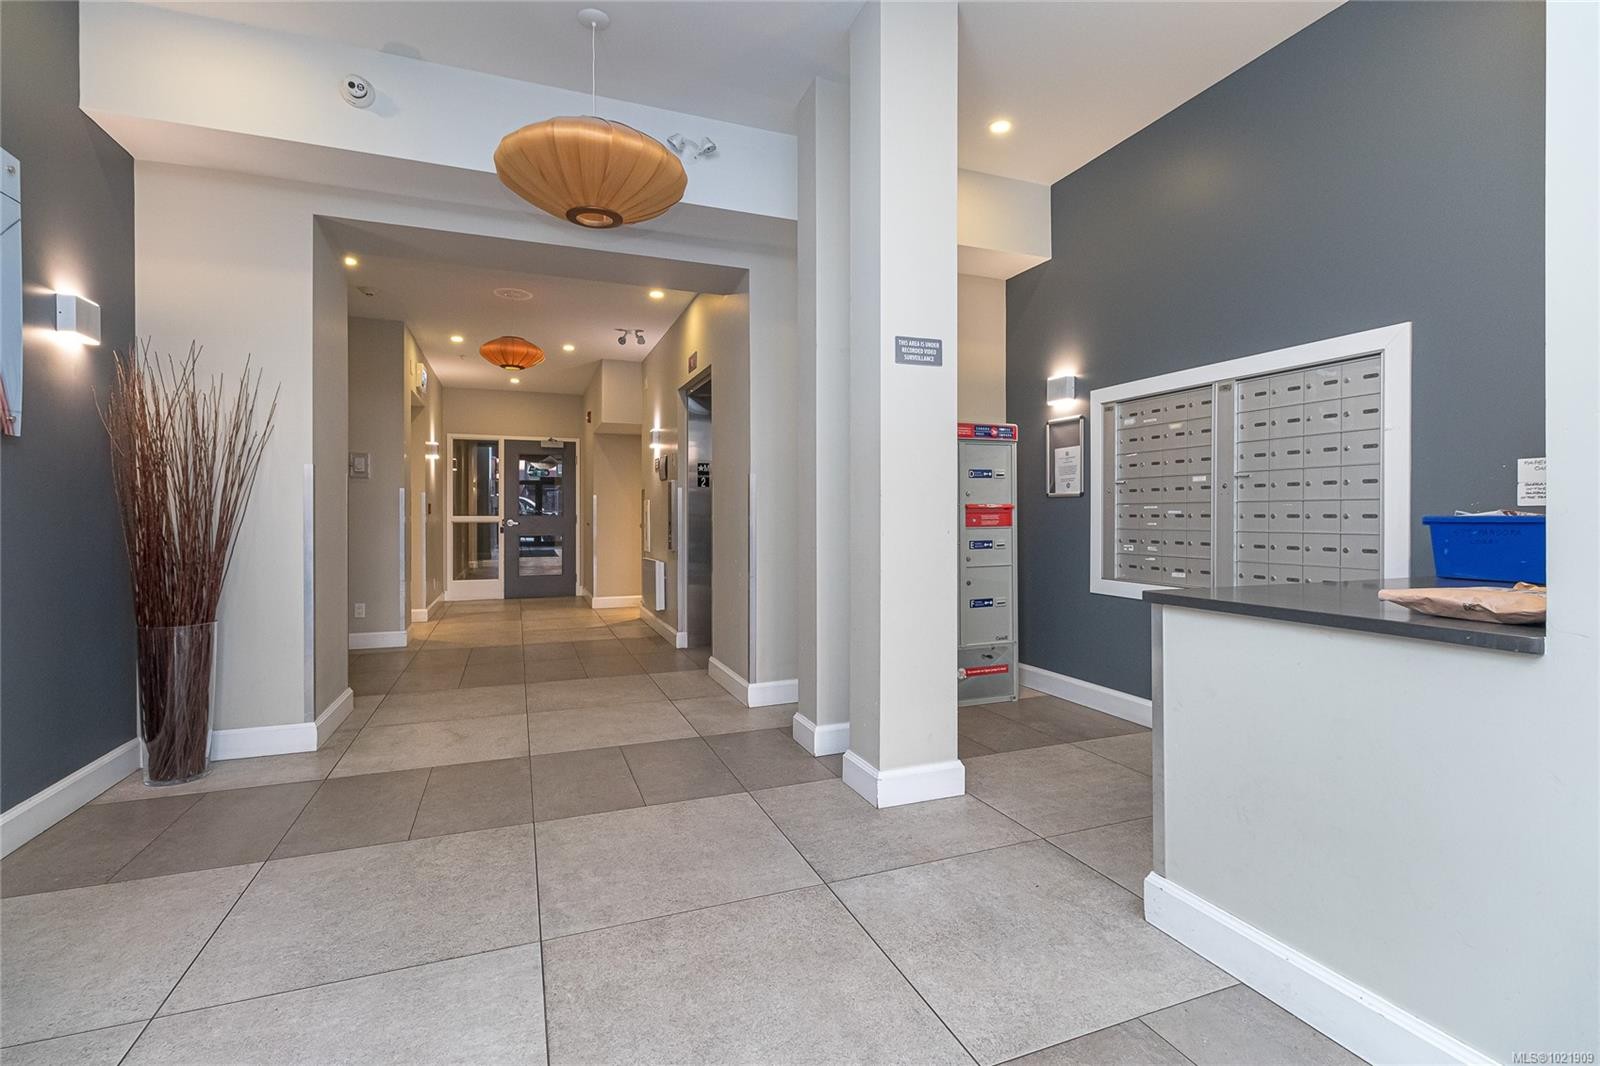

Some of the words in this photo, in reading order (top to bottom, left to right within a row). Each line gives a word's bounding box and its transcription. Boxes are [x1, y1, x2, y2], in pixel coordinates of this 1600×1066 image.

[925, 341, 940, 349] UNDER
[901, 346, 924, 354] RECORDED
[924, 348, 937, 356] VIDEO
[701, 477, 706, 488] 2
